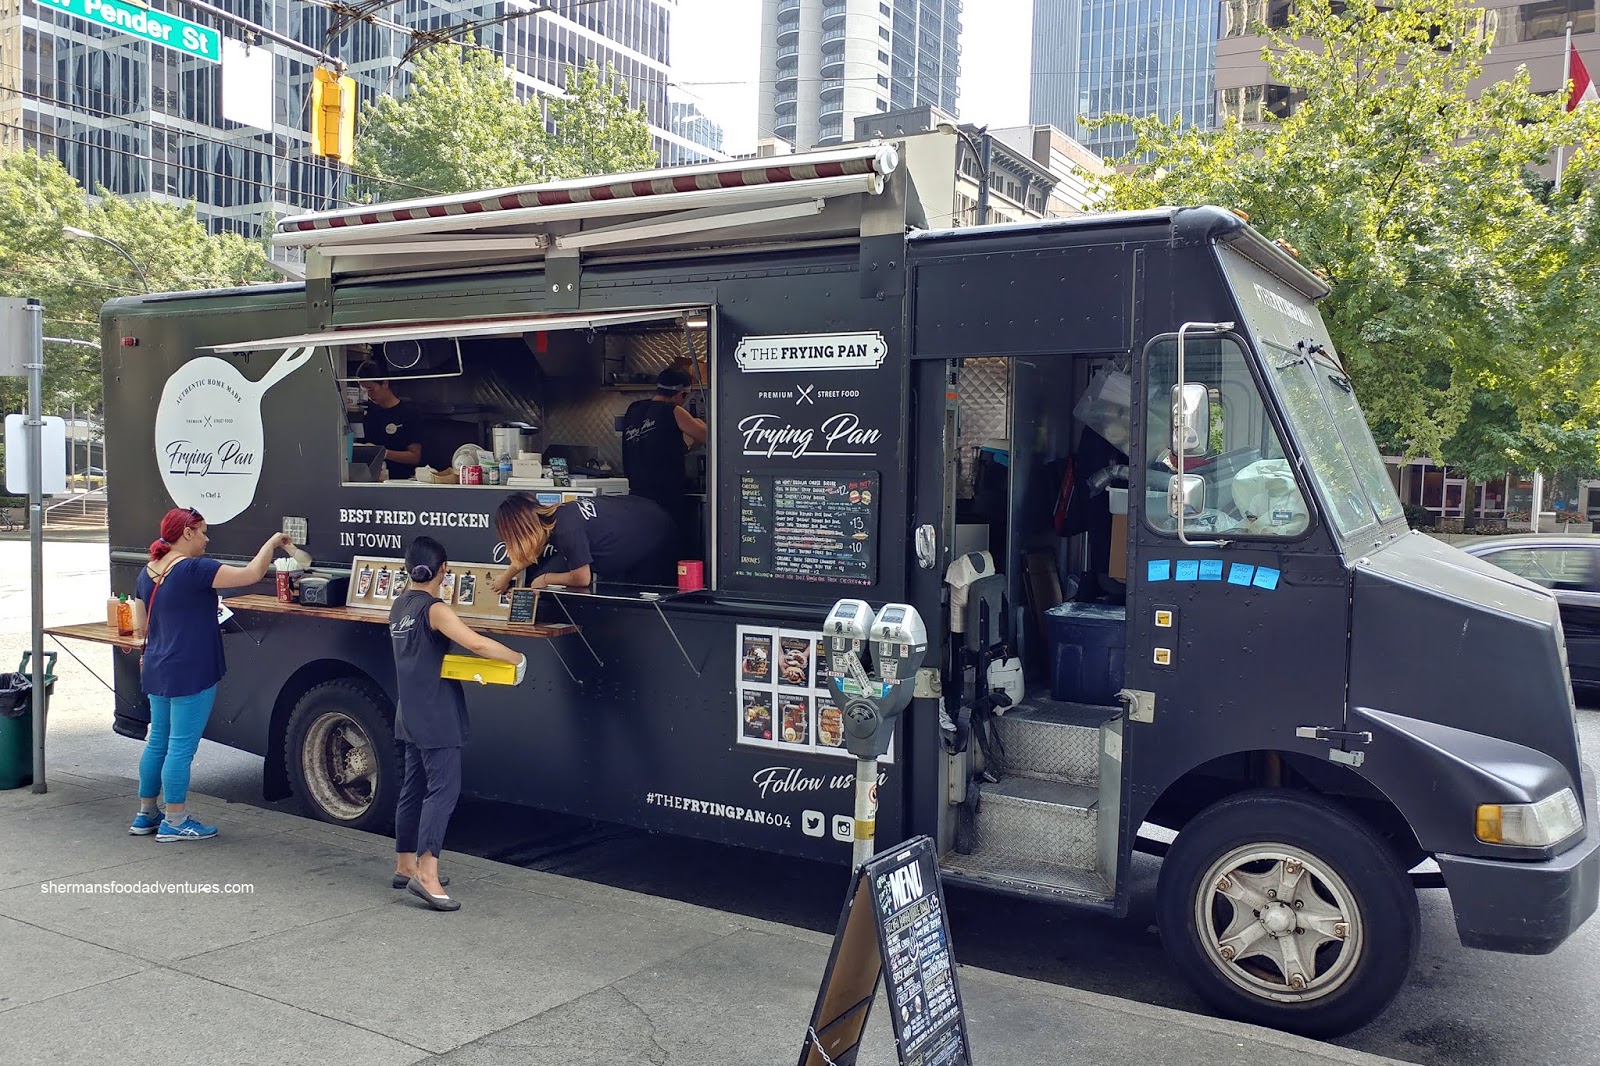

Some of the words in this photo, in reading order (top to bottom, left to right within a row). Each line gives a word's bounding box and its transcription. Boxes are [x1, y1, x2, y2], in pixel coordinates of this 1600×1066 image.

[85, 0, 172, 41] Pender
[182, 26, 209, 54] St
[751, 348, 778, 360] THE
[781, 345, 834, 359] FRYING
[838, 344, 867, 358] PAN
[176, 379, 206, 405] AUTHENTIC
[207, 379, 225, 389] HOME
[226, 386, 242, 403] MADE
[758, 391, 793, 399] PREMIUM
[817, 390, 840, 398] STREET
[841, 390, 860, 398] FOOD
[738, 414, 814, 459] Frying
[821, 413, 882, 452] Pan
[165, 440, 213, 477] Frying
[217, 439, 255, 471] Pan
[340, 508, 372, 524] BEST
[375, 510, 416, 526] FRIED
[419, 511, 490, 529] CHICKEN
[340, 532, 355, 547] IN
[358, 533, 402, 549] TOWN
[1234, 565, 1249, 573] SOLD
[753, 766, 824, 799] Follow
[829, 773, 856, 789] us
[646, 791, 792, 828] #THEFRYINGPAN604
[889, 859, 923, 911] MENU
